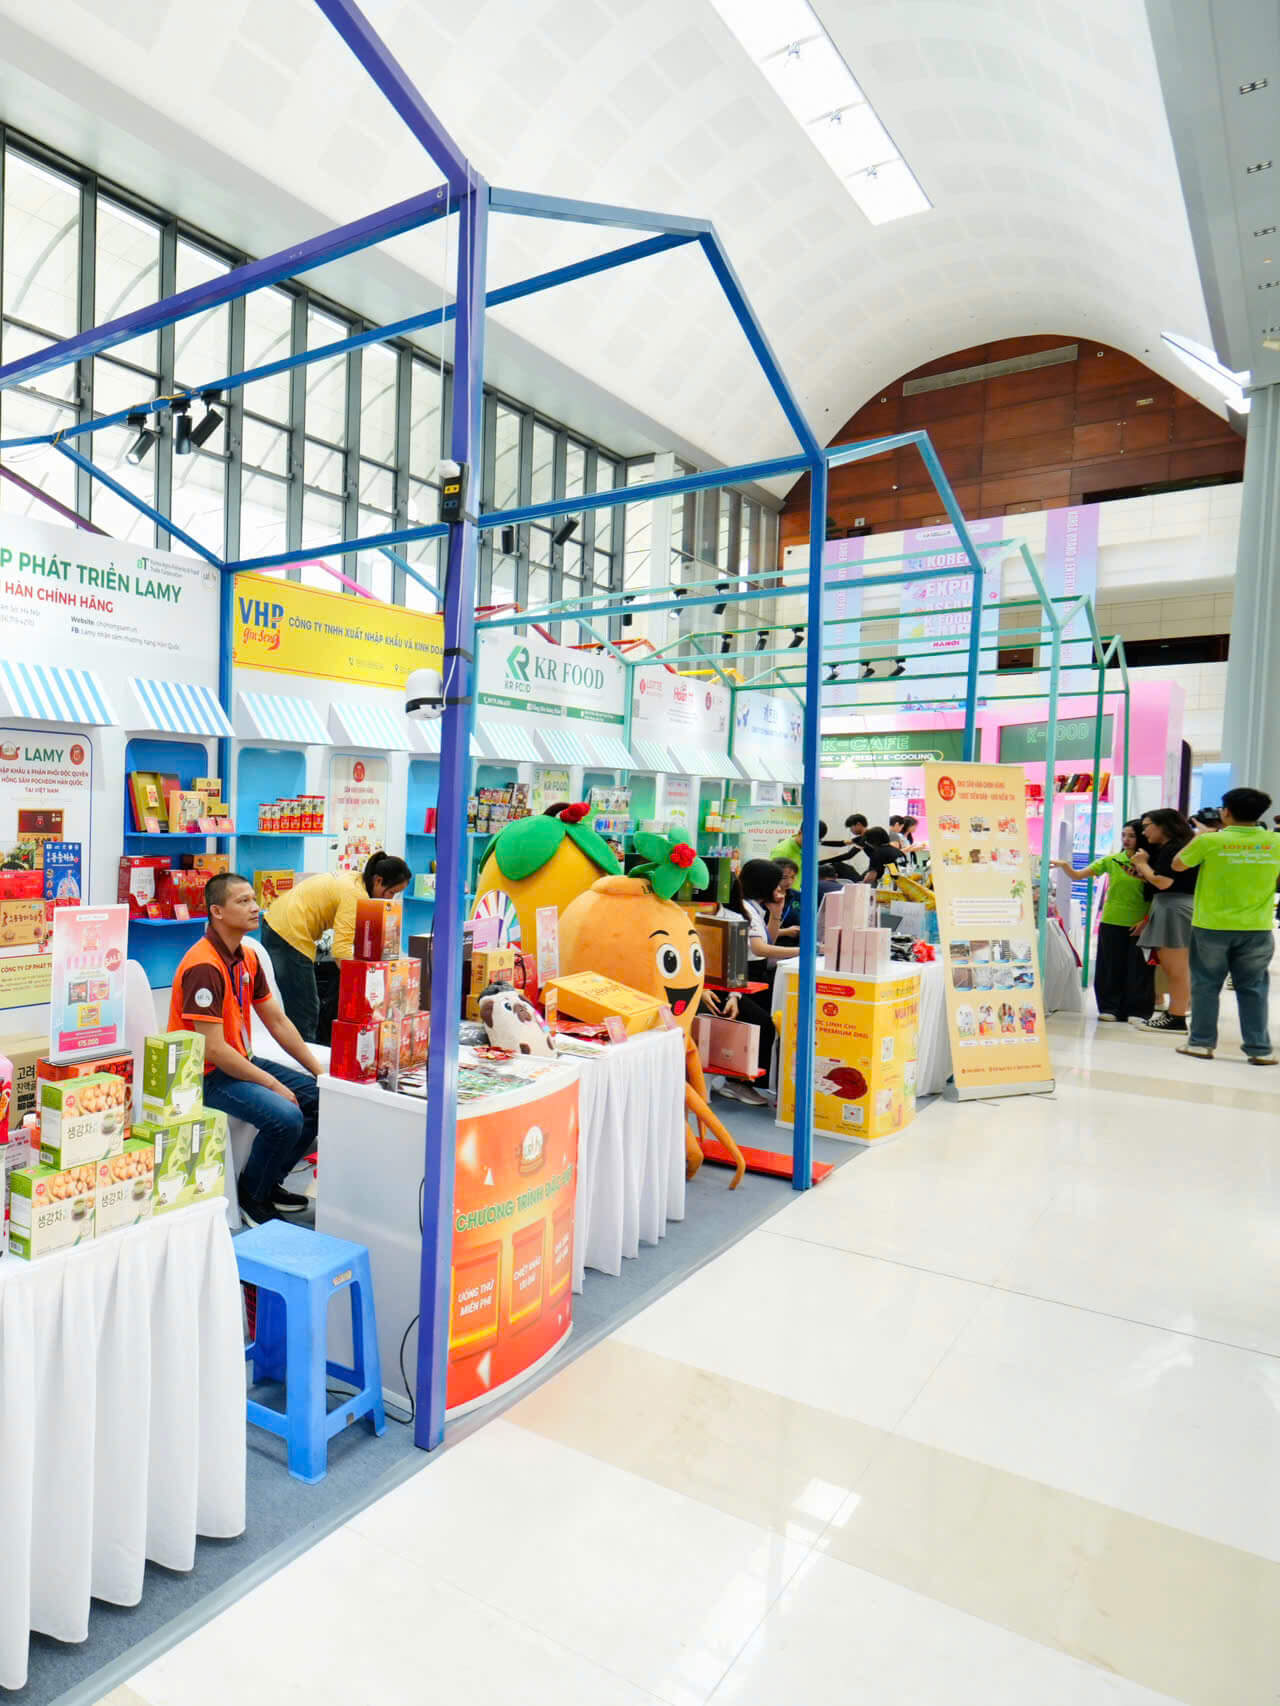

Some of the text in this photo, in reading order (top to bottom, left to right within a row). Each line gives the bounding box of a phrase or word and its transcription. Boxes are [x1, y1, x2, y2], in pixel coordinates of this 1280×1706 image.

[5, 581, 33, 599] HÀN
[37, 587, 77, 606] CHÍNH
[19, 551, 72, 580] PHÁT
[77, 562, 130, 593] TRIỂN
[135, 577, 182, 604] LAMY
[239, 596, 284, 629] VHP
[289, 616, 312, 630] CÔNG
[314, 623, 322, 633] TY
[324, 624, 343, 637] TNHH
[345, 627, 363, 640] XUẤT
[415, 641, 429, 651] KINH
[535, 656, 604, 689] KR FOOD
[822, 736, 909, 752] K-CAFE
[1026, 722, 1089, 744] K-OOD
[25, 748, 64, 762] LAMY
[456, 1198, 515, 1232] CHƯƠNG
[517, 1183, 545, 1209] TRÌNH
